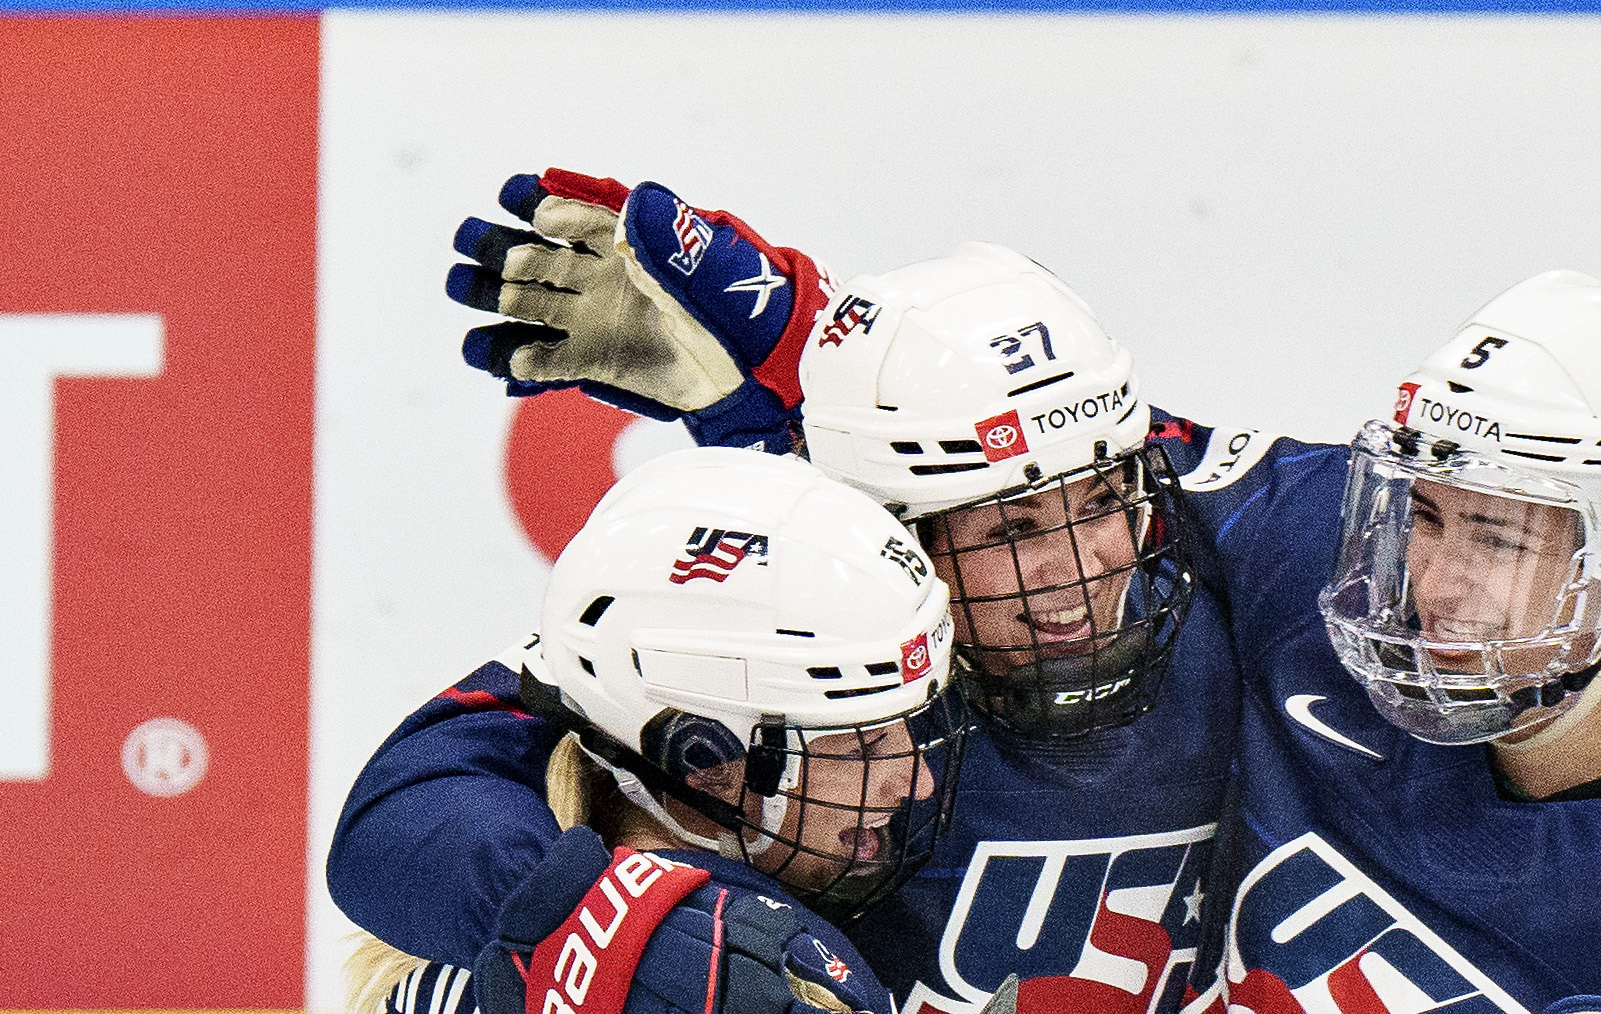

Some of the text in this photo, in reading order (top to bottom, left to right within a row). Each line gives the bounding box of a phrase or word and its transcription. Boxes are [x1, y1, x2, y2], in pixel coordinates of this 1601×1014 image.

[989, 321, 1056, 375] 27
[1460, 336, 1508, 370] 5
[1030, 389, 1124, 434] TOYOTA
[1420, 397, 1501, 442] TOYOTA
[668, 526, 769, 585] USA
